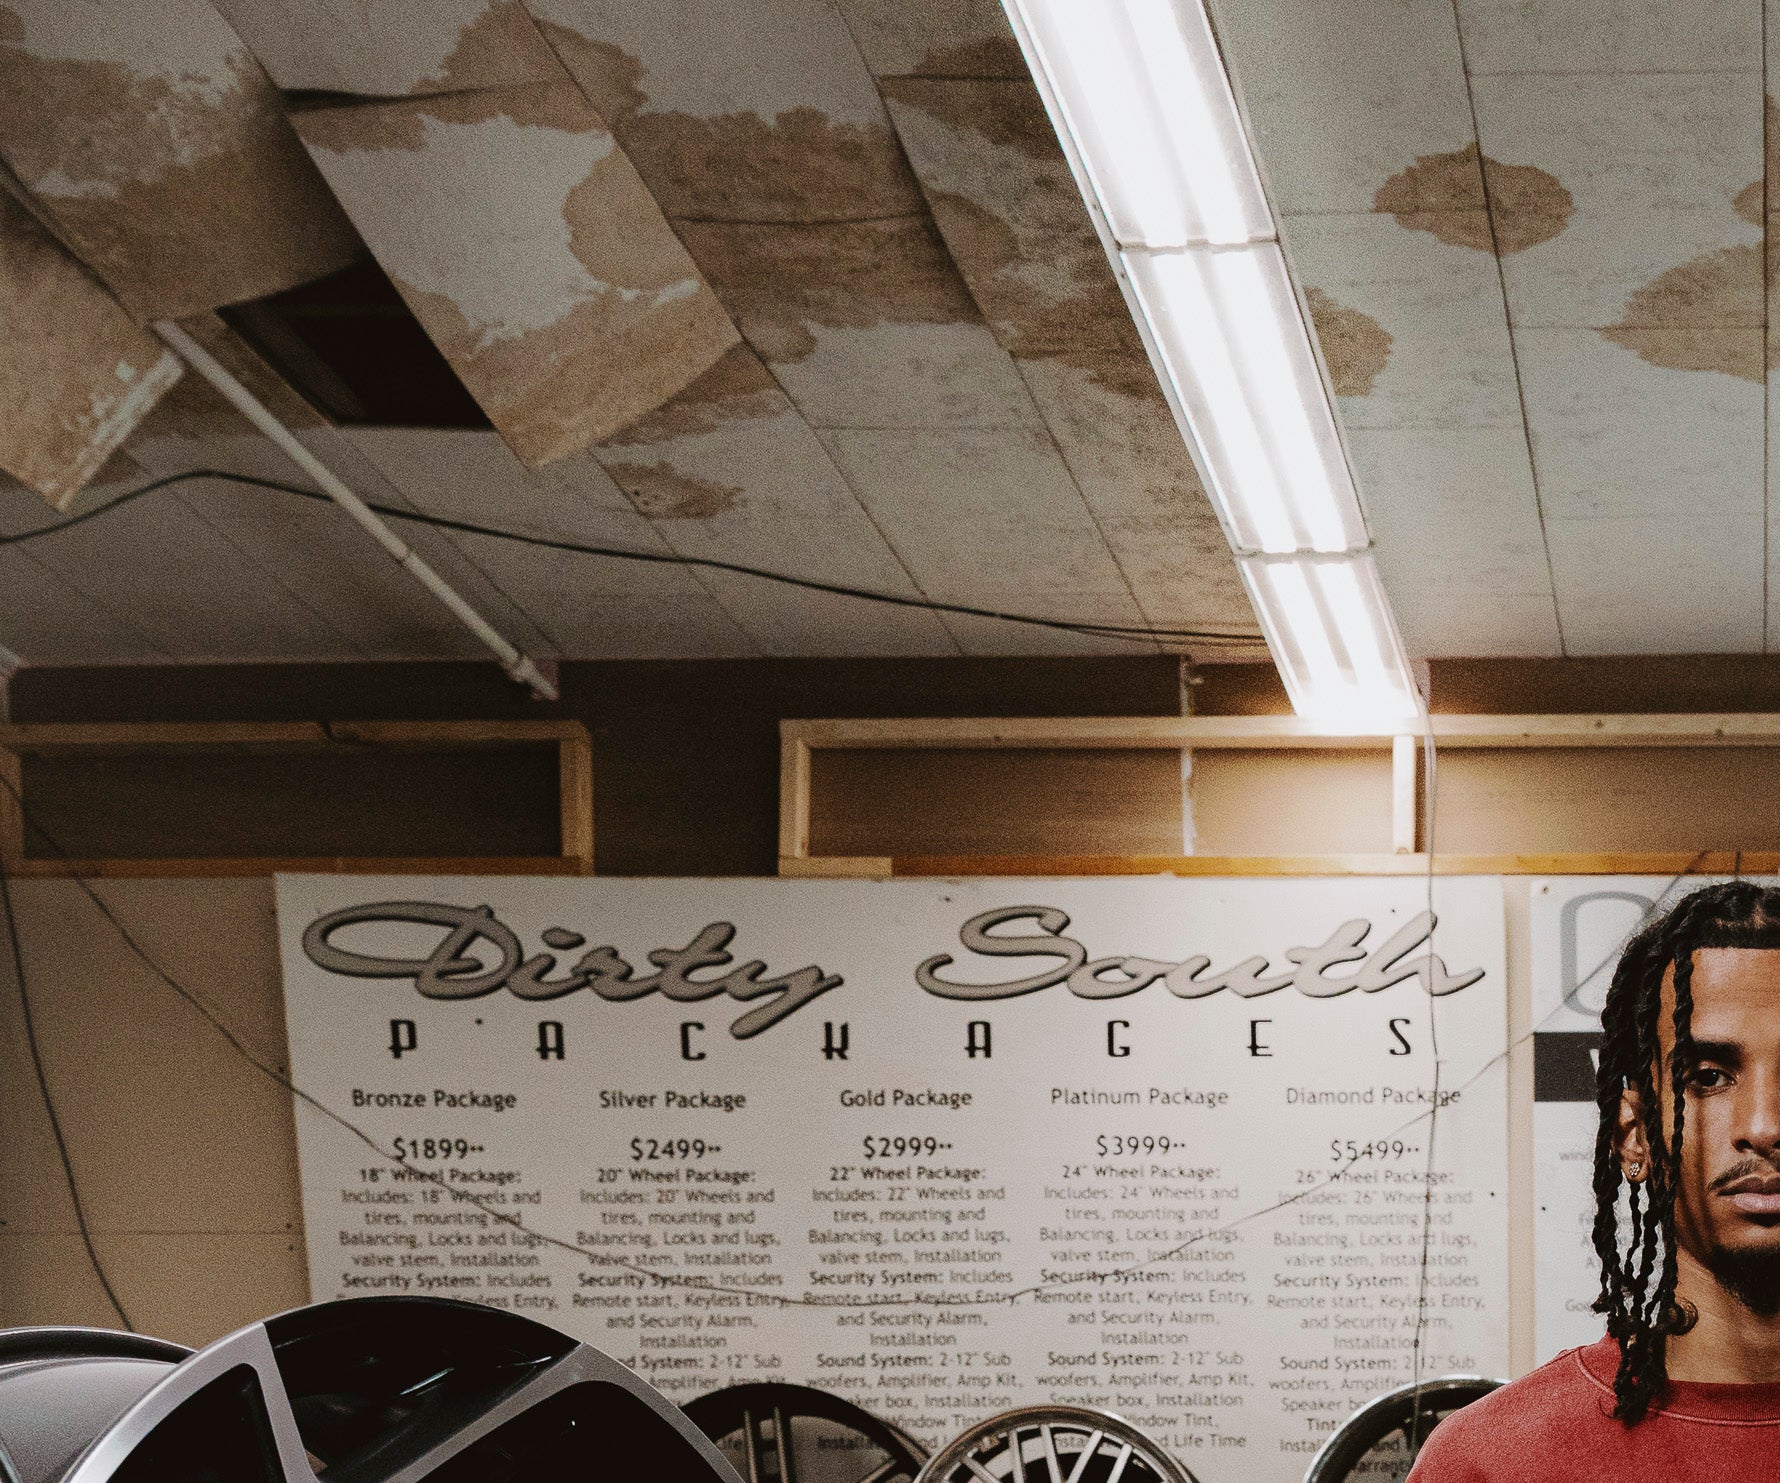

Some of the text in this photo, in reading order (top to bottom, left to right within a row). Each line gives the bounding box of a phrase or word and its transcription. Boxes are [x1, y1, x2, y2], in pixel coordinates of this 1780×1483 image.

[302, 900, 1486, 1040] Dirty South
[351, 1088, 518, 1113] Bronze Package
[598, 1089, 747, 1114] Silver Package
[839, 1088, 973, 1111] Gold Package
[1050, 1087, 1229, 1109] Platinum Package
[1286, 1084, 1462, 1109] Diamond Package
